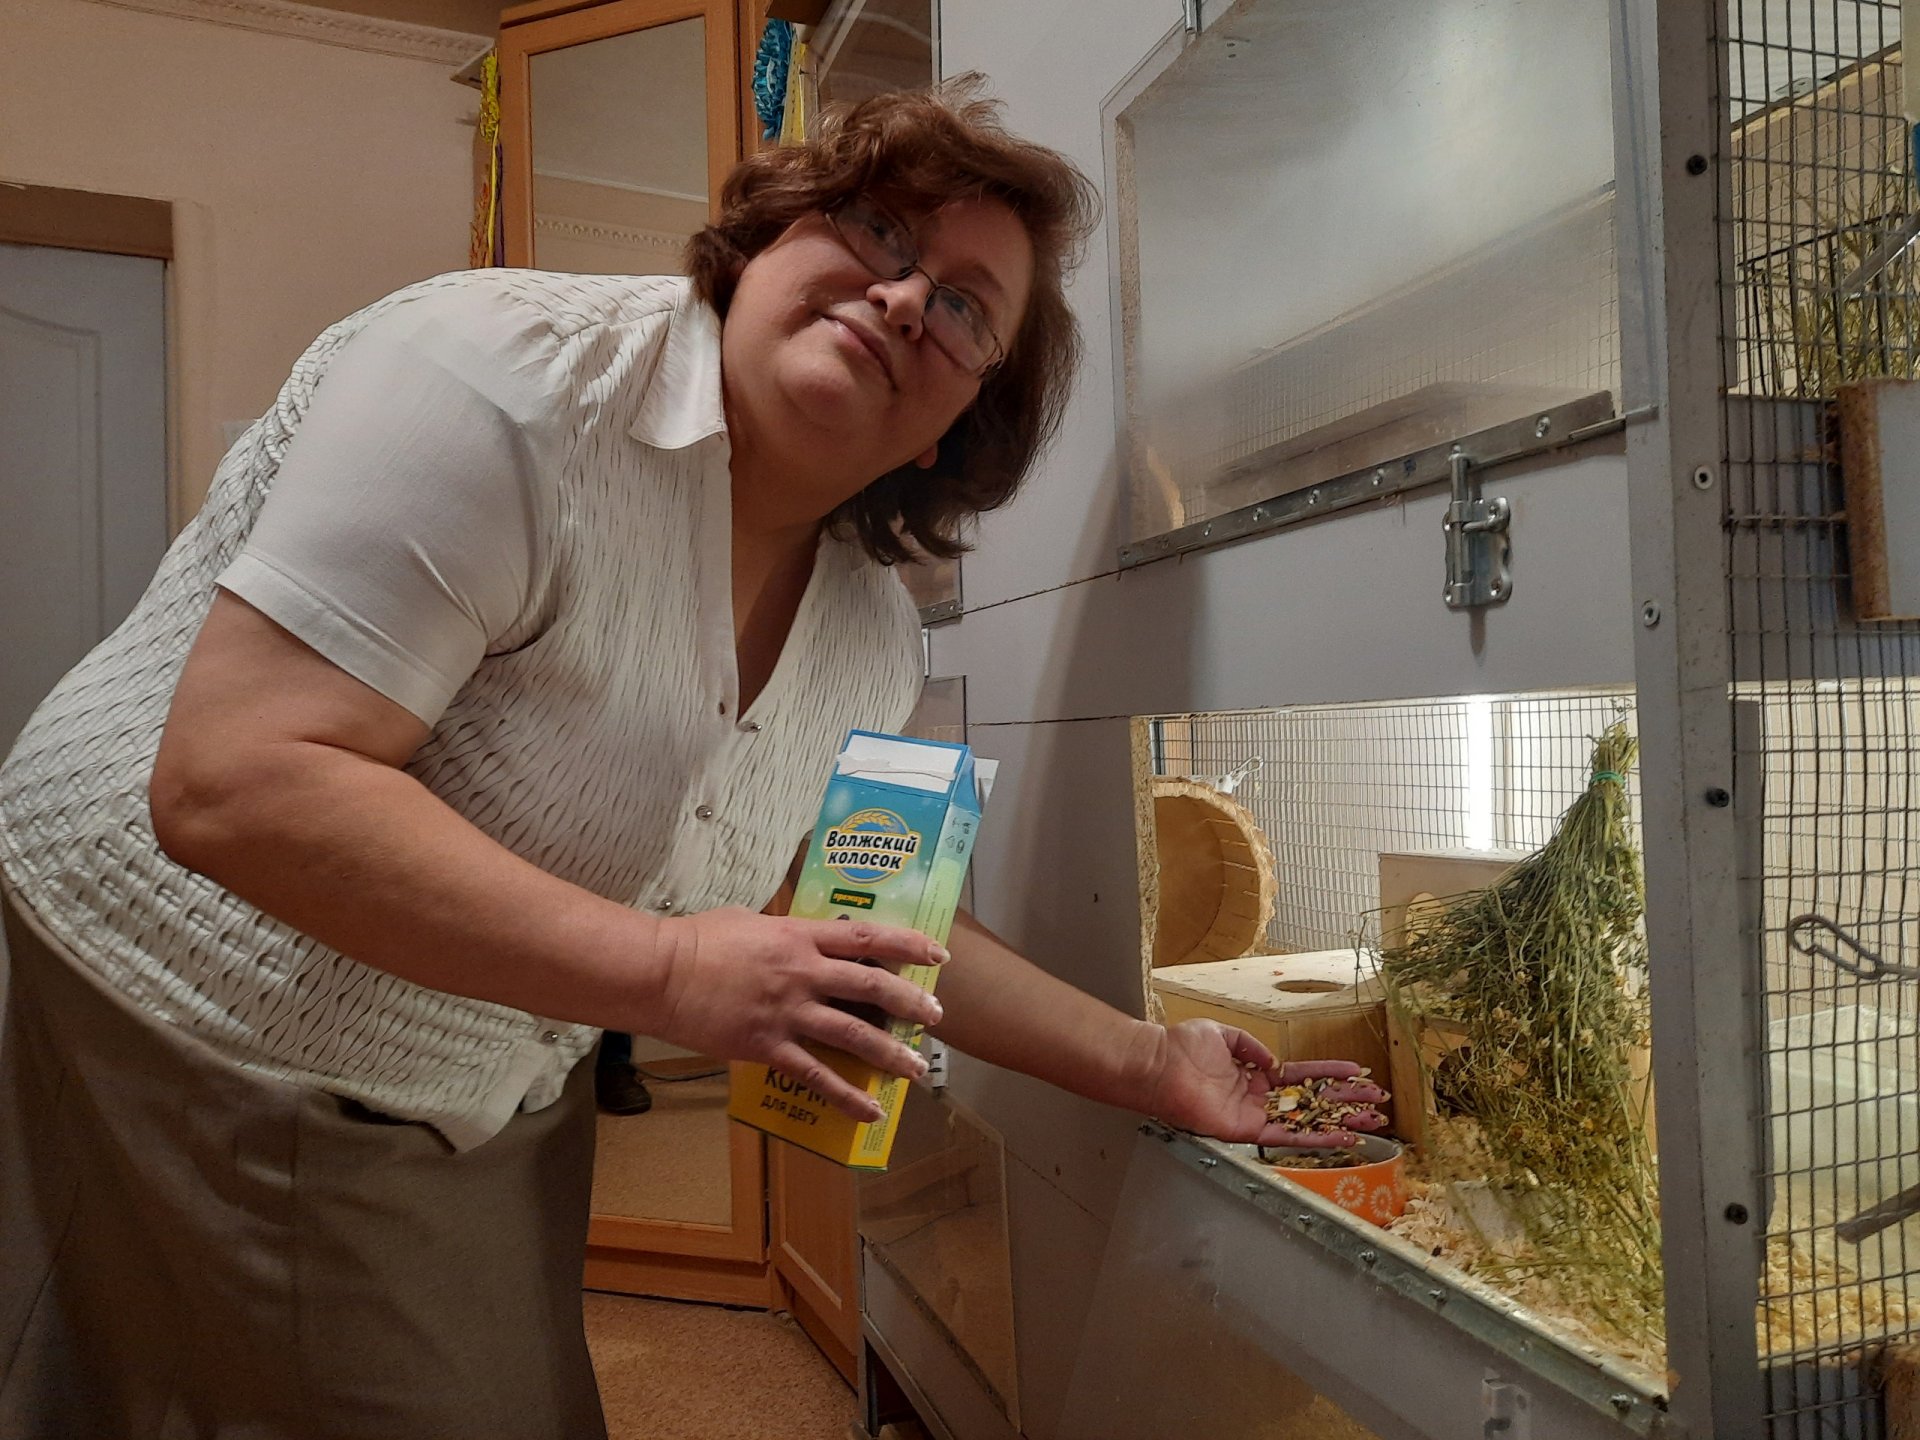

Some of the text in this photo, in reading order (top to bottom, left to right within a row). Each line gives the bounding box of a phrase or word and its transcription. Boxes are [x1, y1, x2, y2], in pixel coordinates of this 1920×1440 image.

[826, 830, 918, 854] Волжский
[827, 851, 902, 869] колосок
[760, 1094, 820, 1126] ДЛЯ ДЕГУ
